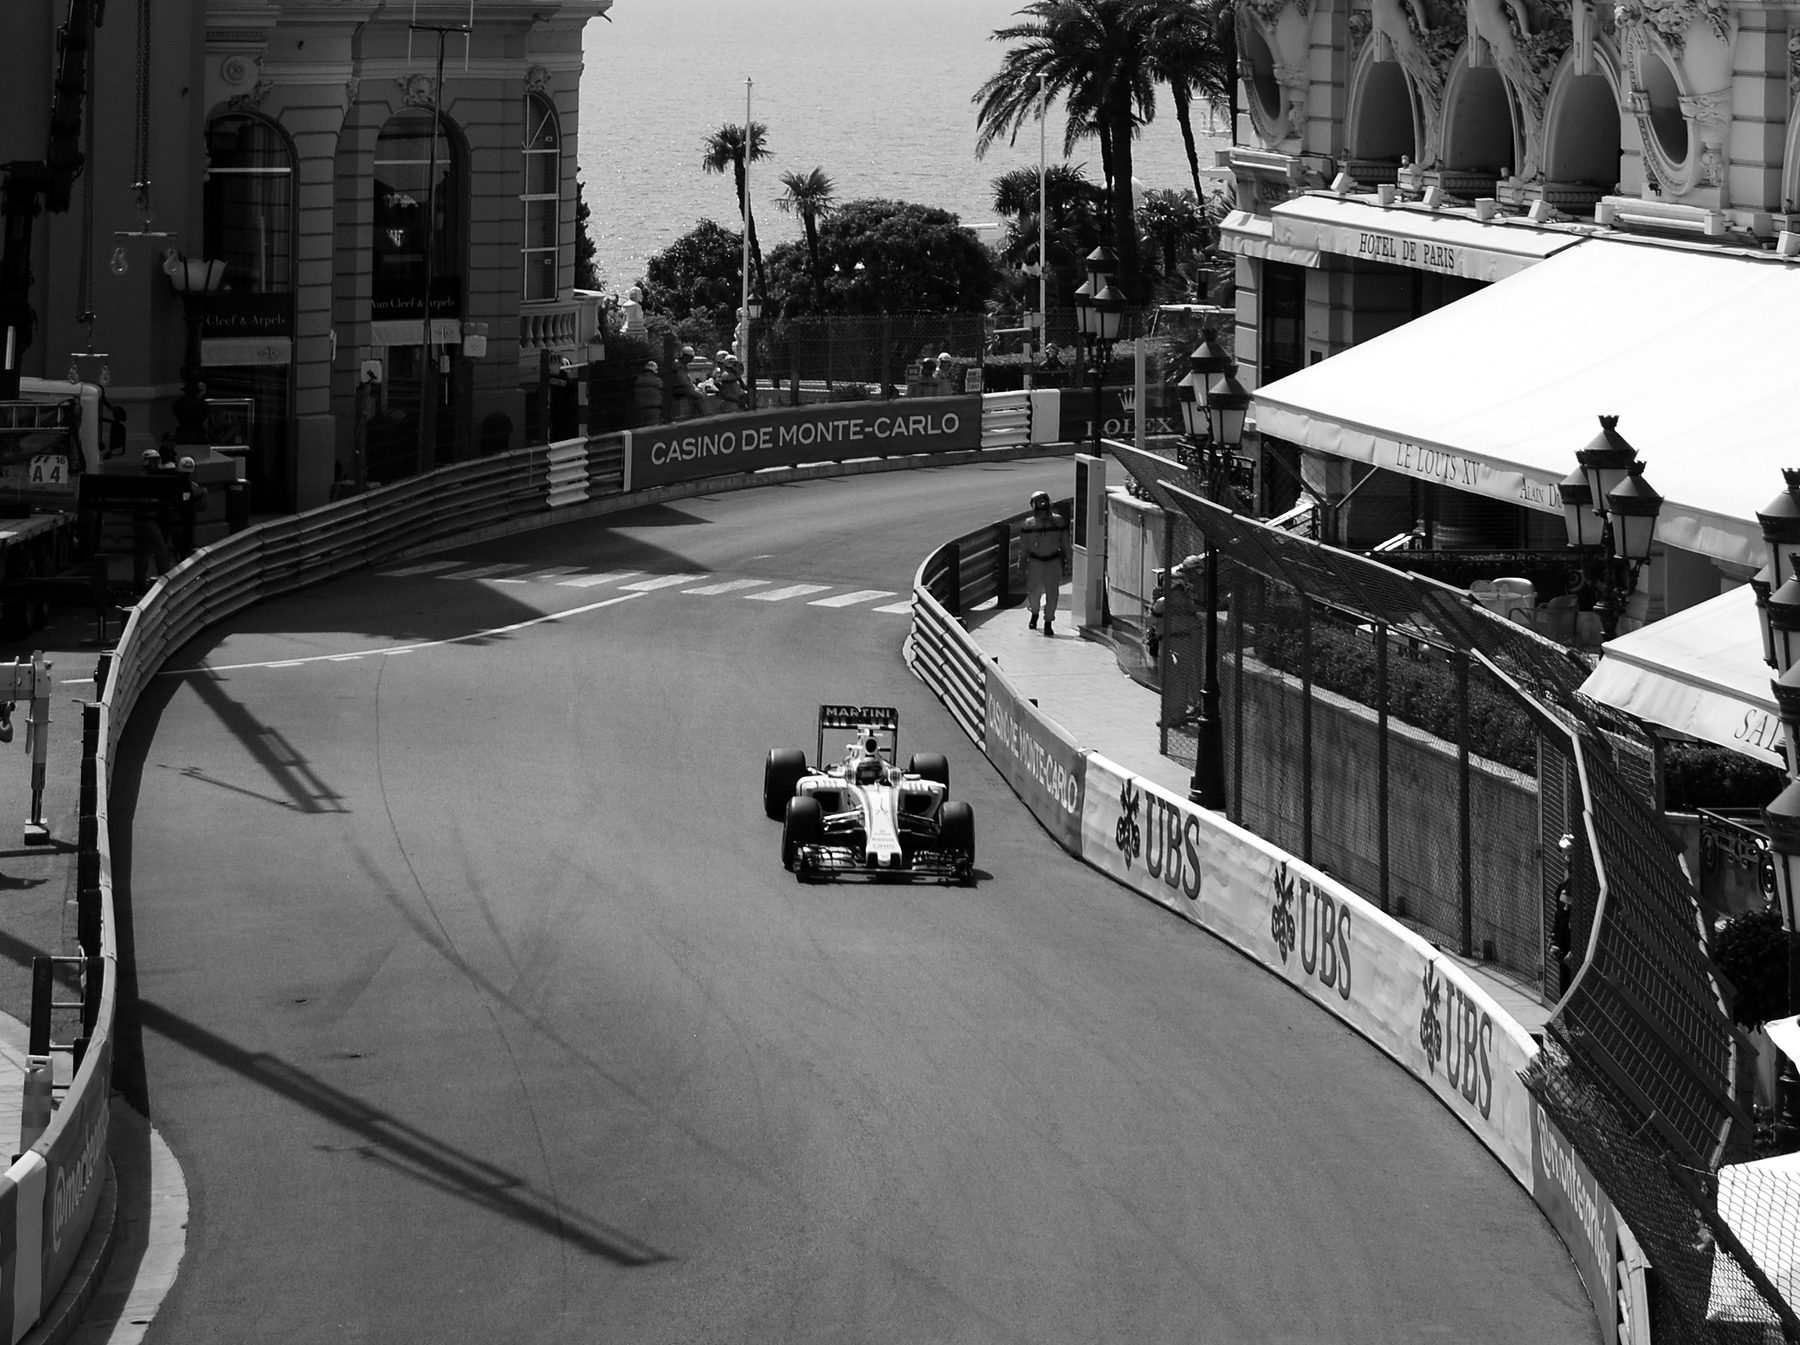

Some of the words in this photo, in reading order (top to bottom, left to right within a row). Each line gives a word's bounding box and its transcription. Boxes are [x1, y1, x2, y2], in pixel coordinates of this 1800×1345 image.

[1359, 233, 1396, 258] HOTEL
[1402, 240, 1416, 262] DE
[1423, 244, 1454, 269] PARIS
[206, 315, 238, 326] Cleef
[239, 316, 247, 325] &
[253, 314, 286, 328] Arpels
[391, 297, 416, 308] Cleef
[417, 299, 424, 308] &
[651, 431, 736, 465] CASINO
[741, 427, 773, 451] DE
[779, 413, 960, 447] MONTE-CARLO
[32, 465, 43, 482] A
[50, 465, 61, 482] 4
[1396, 441, 1413, 469] LE
[1416, 447, 1457, 481] LOUIS
[1462, 459, 1481, 486] XV
[826, 707, 890, 718] MARTINI
[1145, 790, 1201, 900] UBS
[1299, 877, 1351, 1001] UBS
[1445, 977, 1492, 1121] UBS
